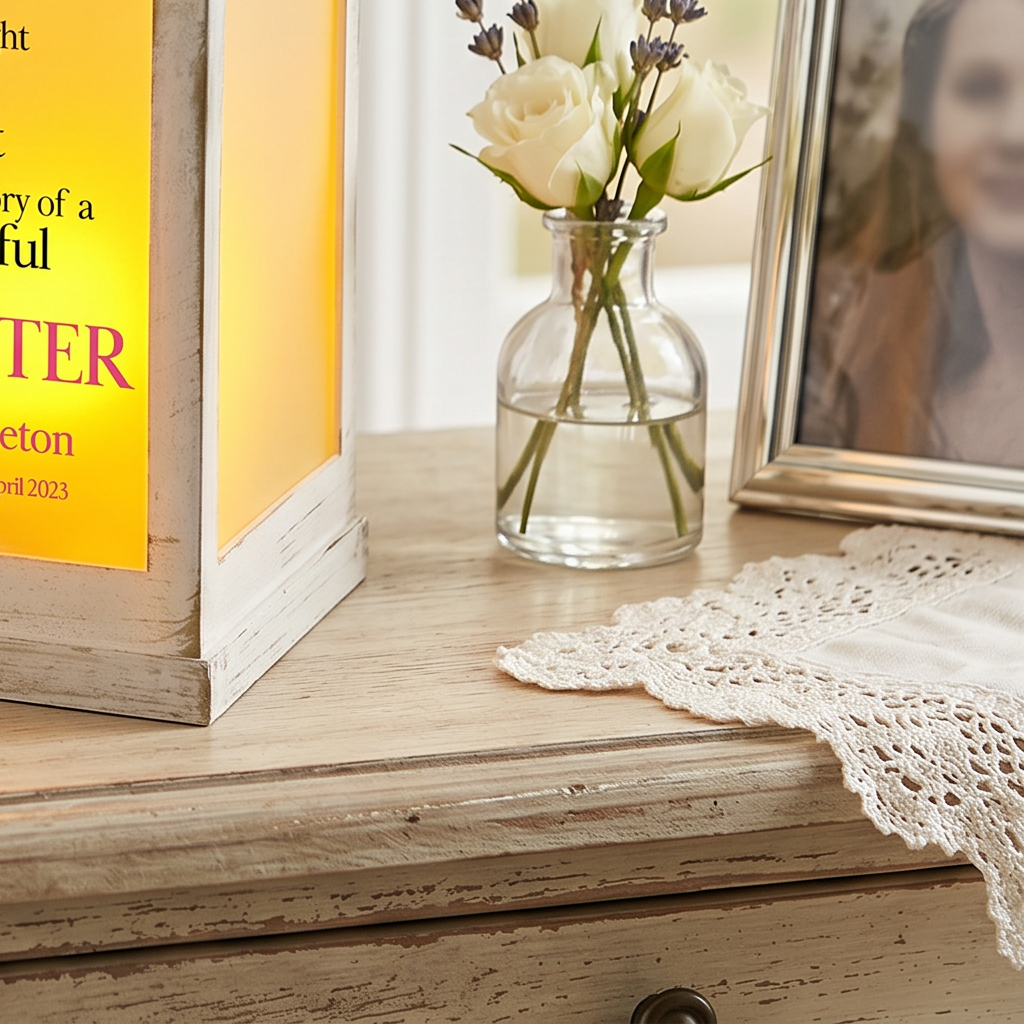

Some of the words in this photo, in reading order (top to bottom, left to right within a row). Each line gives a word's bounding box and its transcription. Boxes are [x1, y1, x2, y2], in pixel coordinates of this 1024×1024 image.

[37, 187, 70, 217] of
[78, 199, 95, 221] a
[27, 478, 69, 501] 2023
